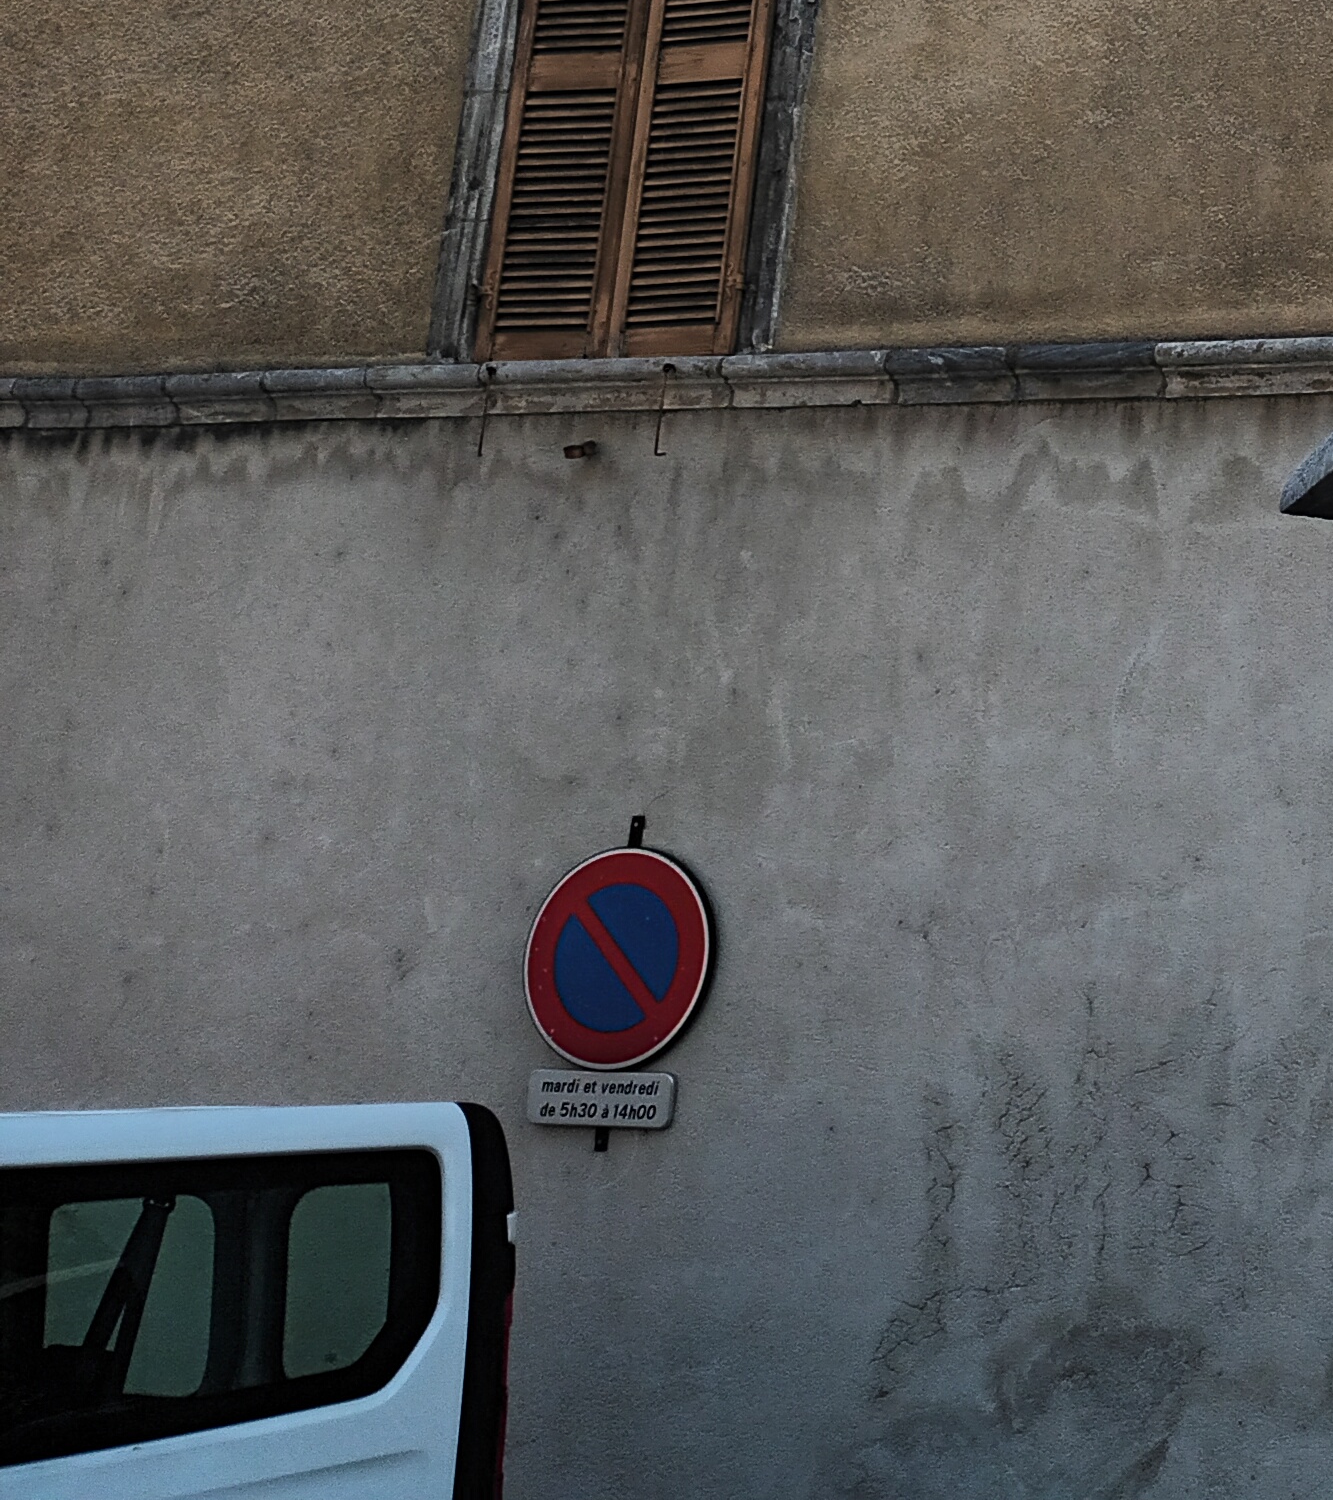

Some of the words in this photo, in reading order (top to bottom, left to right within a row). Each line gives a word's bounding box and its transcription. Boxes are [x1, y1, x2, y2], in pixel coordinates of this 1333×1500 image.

[541, 1078, 581, 1094] mardi
[583, 1080, 597, 1094] et
[601, 1080, 660, 1096] vendredi
[539, 1102, 556, 1118] de
[560, 1101, 597, 1119] 5h30
[601, 1105, 609, 1119] à
[613, 1103, 657, 1120] 14h00
